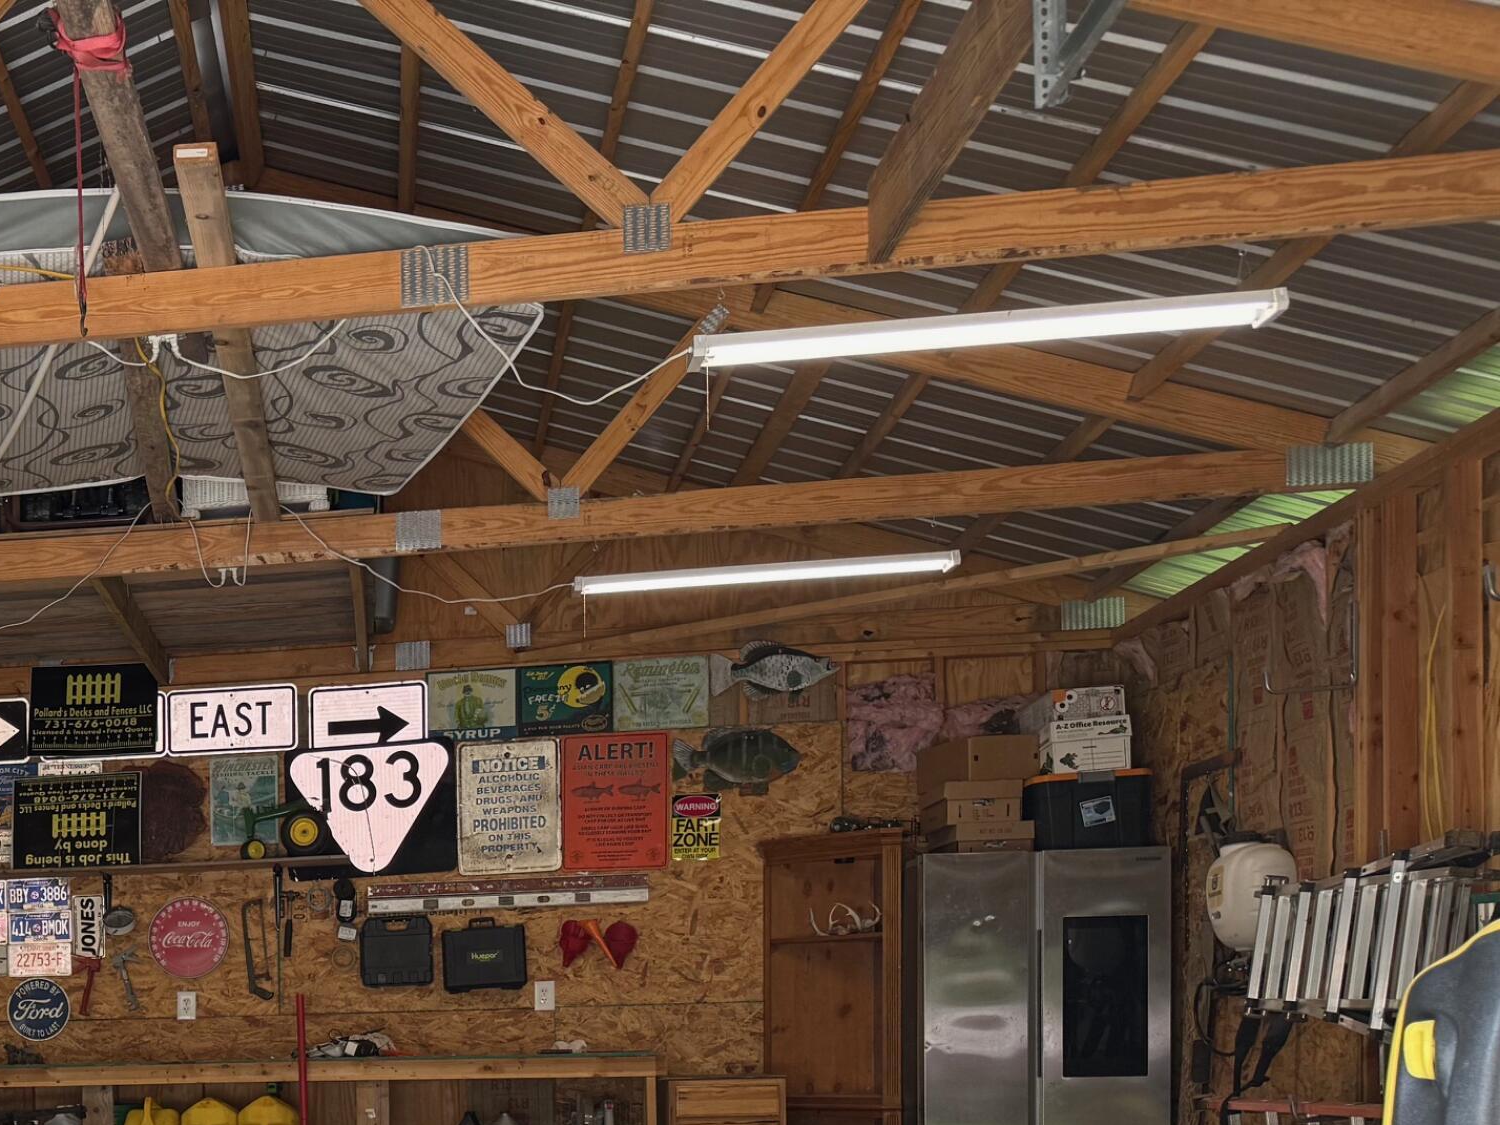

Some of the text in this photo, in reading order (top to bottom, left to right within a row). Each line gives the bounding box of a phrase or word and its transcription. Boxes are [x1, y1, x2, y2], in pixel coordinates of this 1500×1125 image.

[34, 704, 152, 718] Pollard's Decks and Fences LLC
[44, 717, 137, 729] 731-676-0048
[190, 701, 273, 740] EAST
[1055, 717, 1127, 730] A-Z Office Resource
[443, 728, 501, 740] SYRUP
[578, 742, 653, 761] ALERT!
[212, 757, 276, 772] WINCHESTER
[479, 757, 540, 773] NOTICE
[11, 767, 30, 778] CITY
[478, 773, 540, 784] ALCOHOLIC
[316, 750, 423, 815] 183
[476, 784, 542, 795] BEVERAGES
[78, 801, 101, 810] Decks
[519, 794, 543, 803] AND
[19, 805, 32, 814] LLC
[33, 803, 59, 812] Fences
[61, 802, 77, 811] and
[482, 805, 537, 815] WEAPONS
[675, 802, 716, 811] WARNING
[473, 815, 547, 833] PROHIBITED
[675, 818, 718, 832] FART
[507, 832, 532, 840] THIS
[673, 832, 719, 847] ZONE
[54, 839, 108, 853] done by
[481, 842, 538, 853] PROPERTY
[25, 852, 131, 867] This Job is being
[9, 886, 67, 903] BBY 3886
[12, 920, 32, 937] 414
[81, 897, 97, 956] JONES
[177, 920, 201, 928] ENJOY
[16, 952, 63, 968] 22753-F
[471, 951, 499, 961] Huepar
[16, 979, 61, 999] POWERED BY
[13, 998, 64, 1021] Ford
[19, 1021, 61, 1038] BUILT TO LAST
